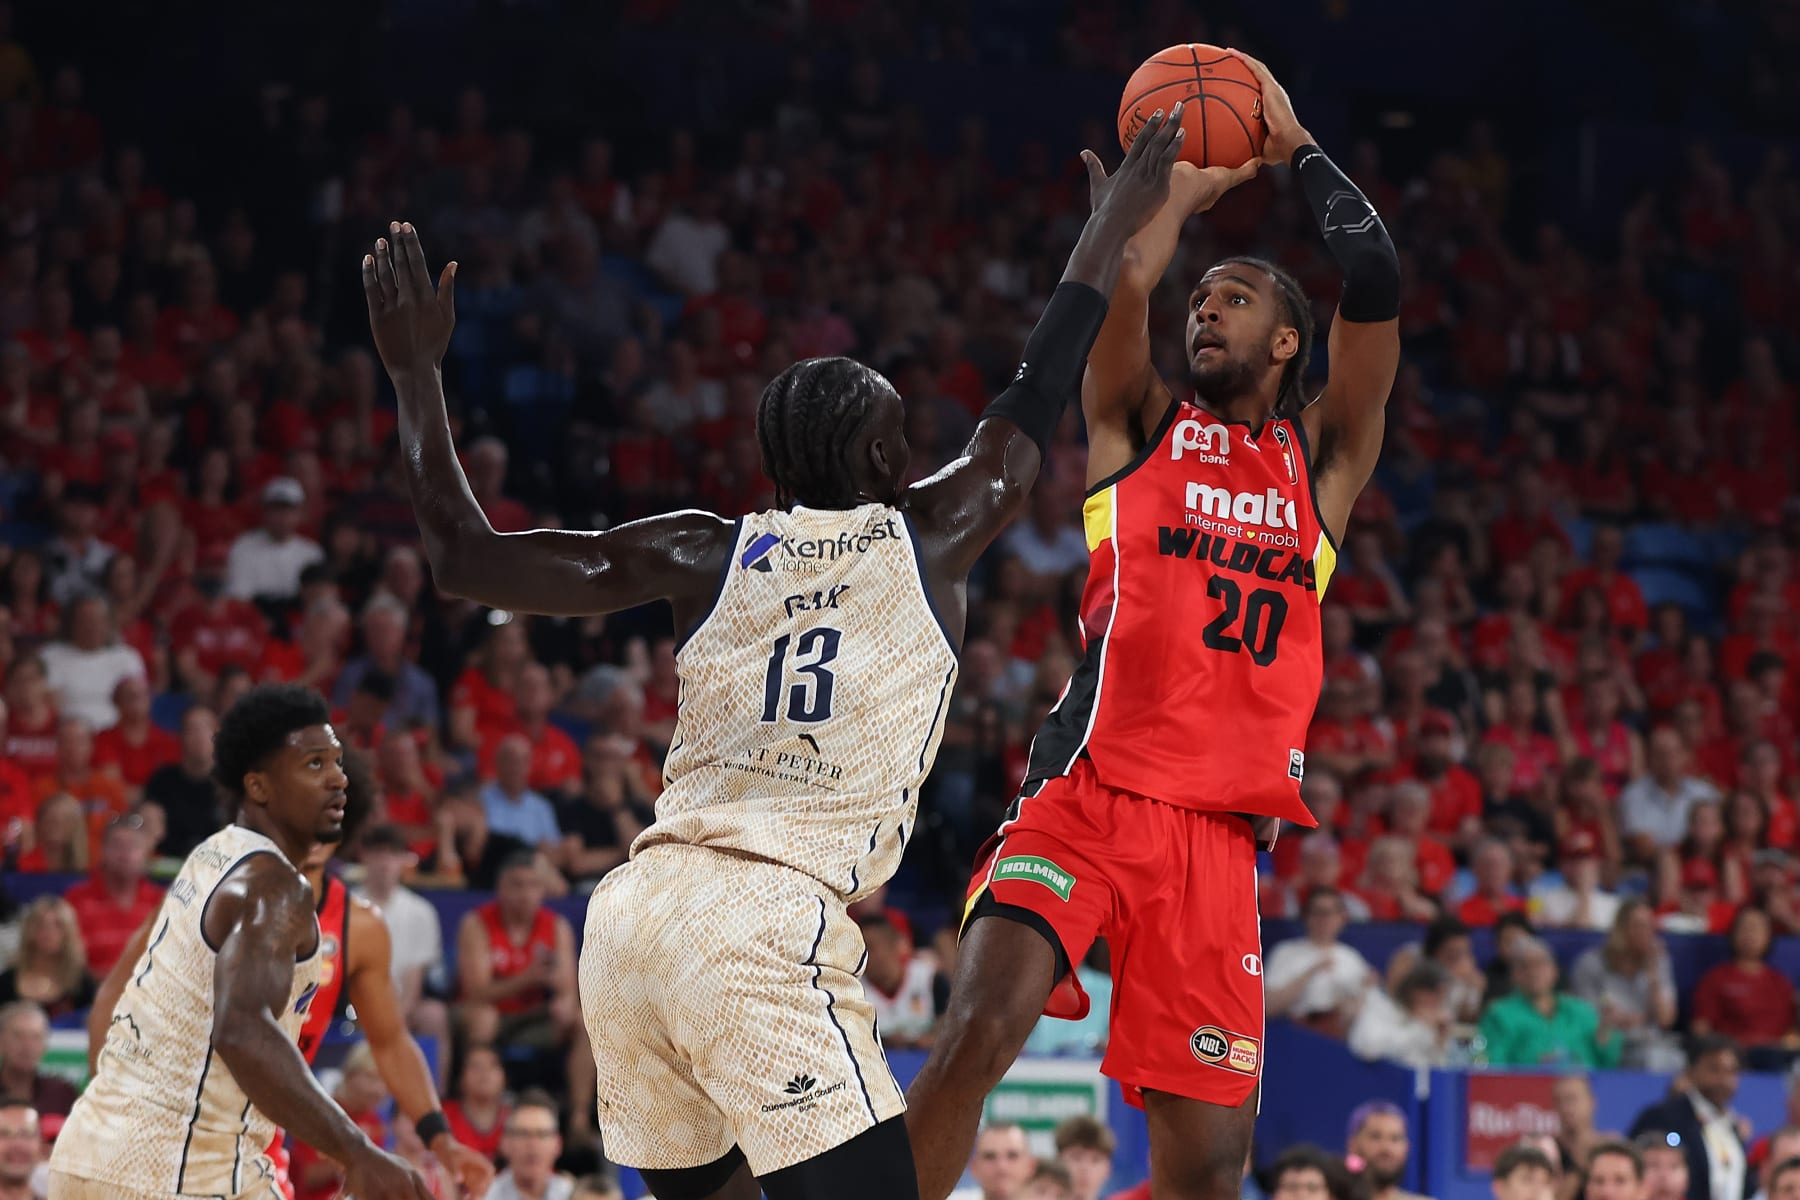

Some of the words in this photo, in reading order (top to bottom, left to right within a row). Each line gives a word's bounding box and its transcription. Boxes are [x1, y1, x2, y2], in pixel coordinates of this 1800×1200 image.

[1199, 453, 1230, 466] bank
[779, 518, 901, 561] Kenfrost
[1184, 510, 1244, 539] internet
[1258, 532, 1301, 549] mobi
[1158, 525, 1317, 592] WILDCAS
[1202, 574, 1289, 667] 20
[760, 626, 843, 723] 13
[776, 752, 843, 780] PETER
[1000, 861, 1069, 891] HOLMAN
[1198, 1035, 1221, 1055] NBL
[761, 1092, 814, 1113] Queensland
[814, 1079, 848, 1098] Country
